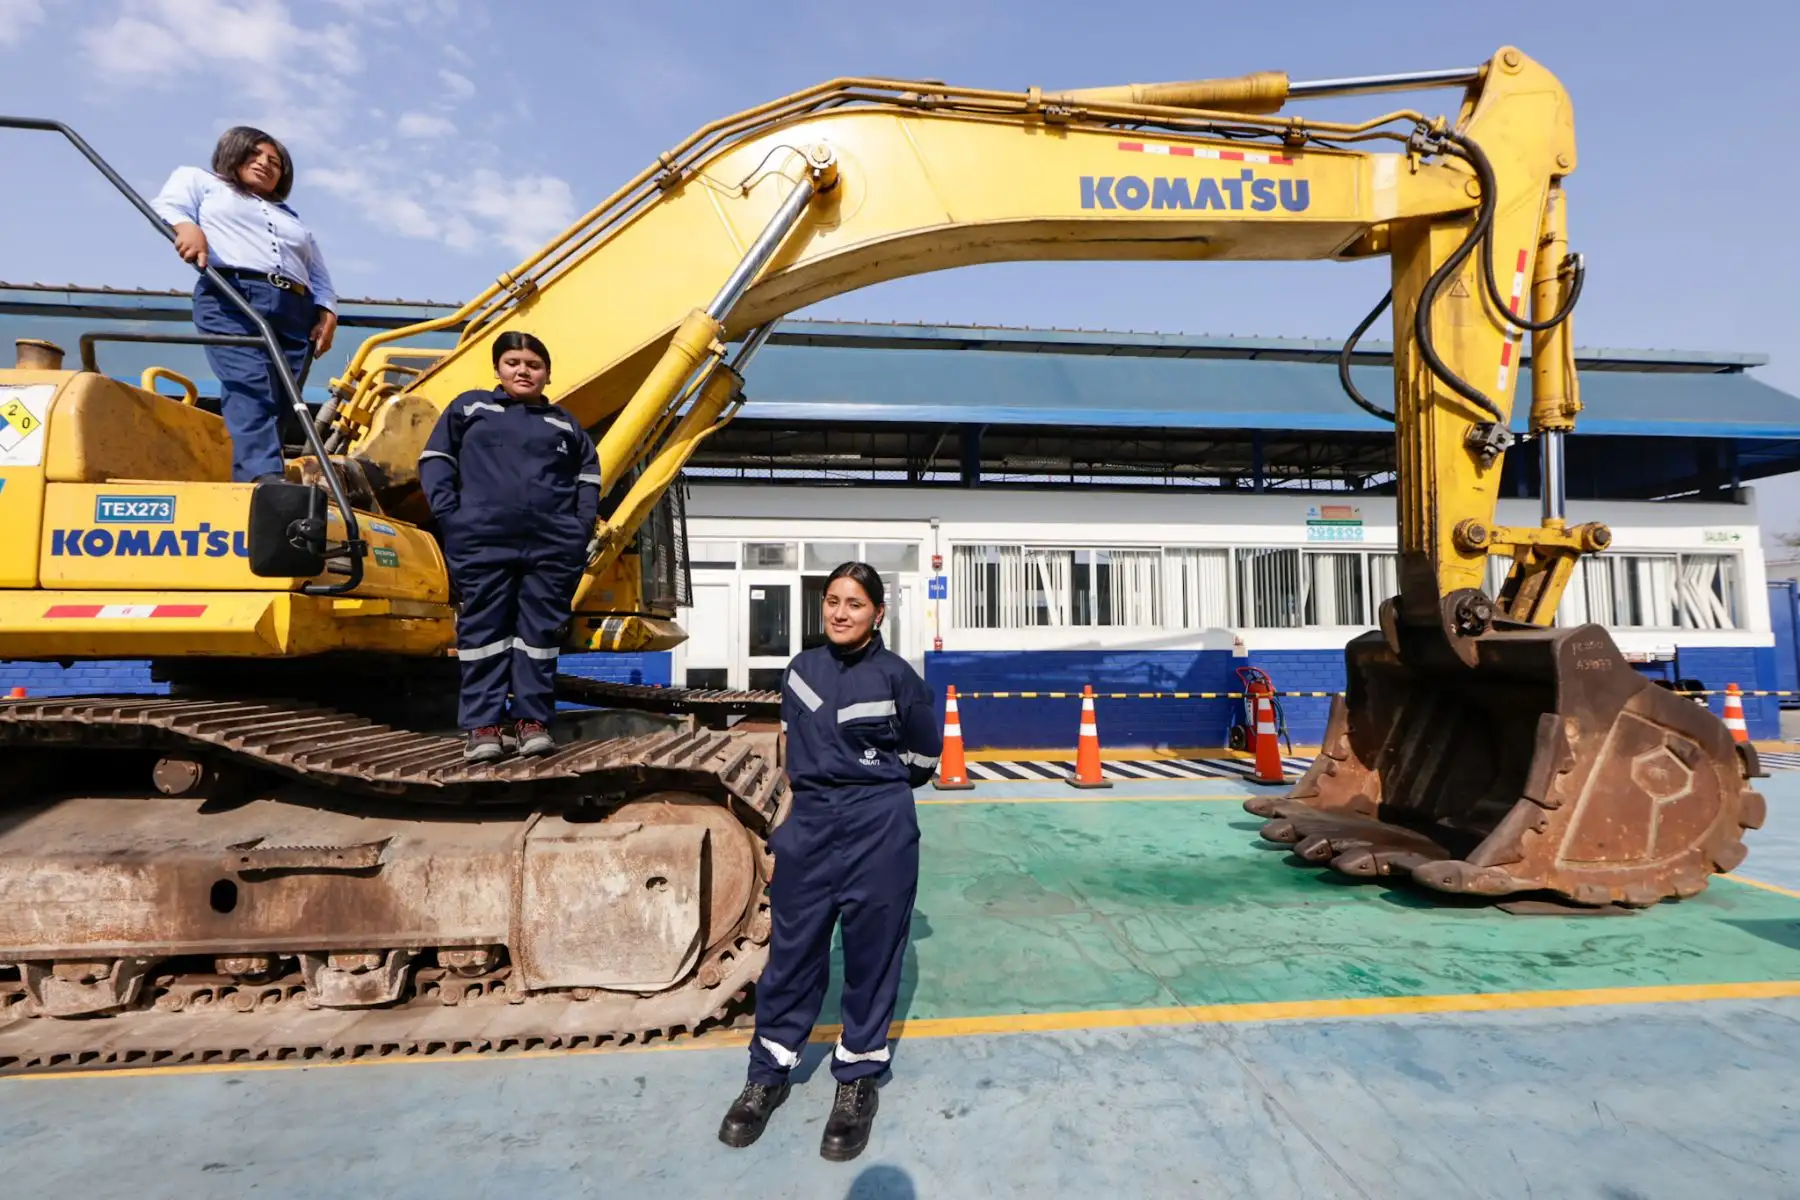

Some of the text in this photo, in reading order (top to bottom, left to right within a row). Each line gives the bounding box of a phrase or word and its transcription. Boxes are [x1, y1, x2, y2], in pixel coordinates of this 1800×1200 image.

[1079, 168, 1310, 212] KOMATSU
[8, 404, 18, 416] 2
[22, 416, 31, 429] 0
[101, 502, 170, 516] TEX273
